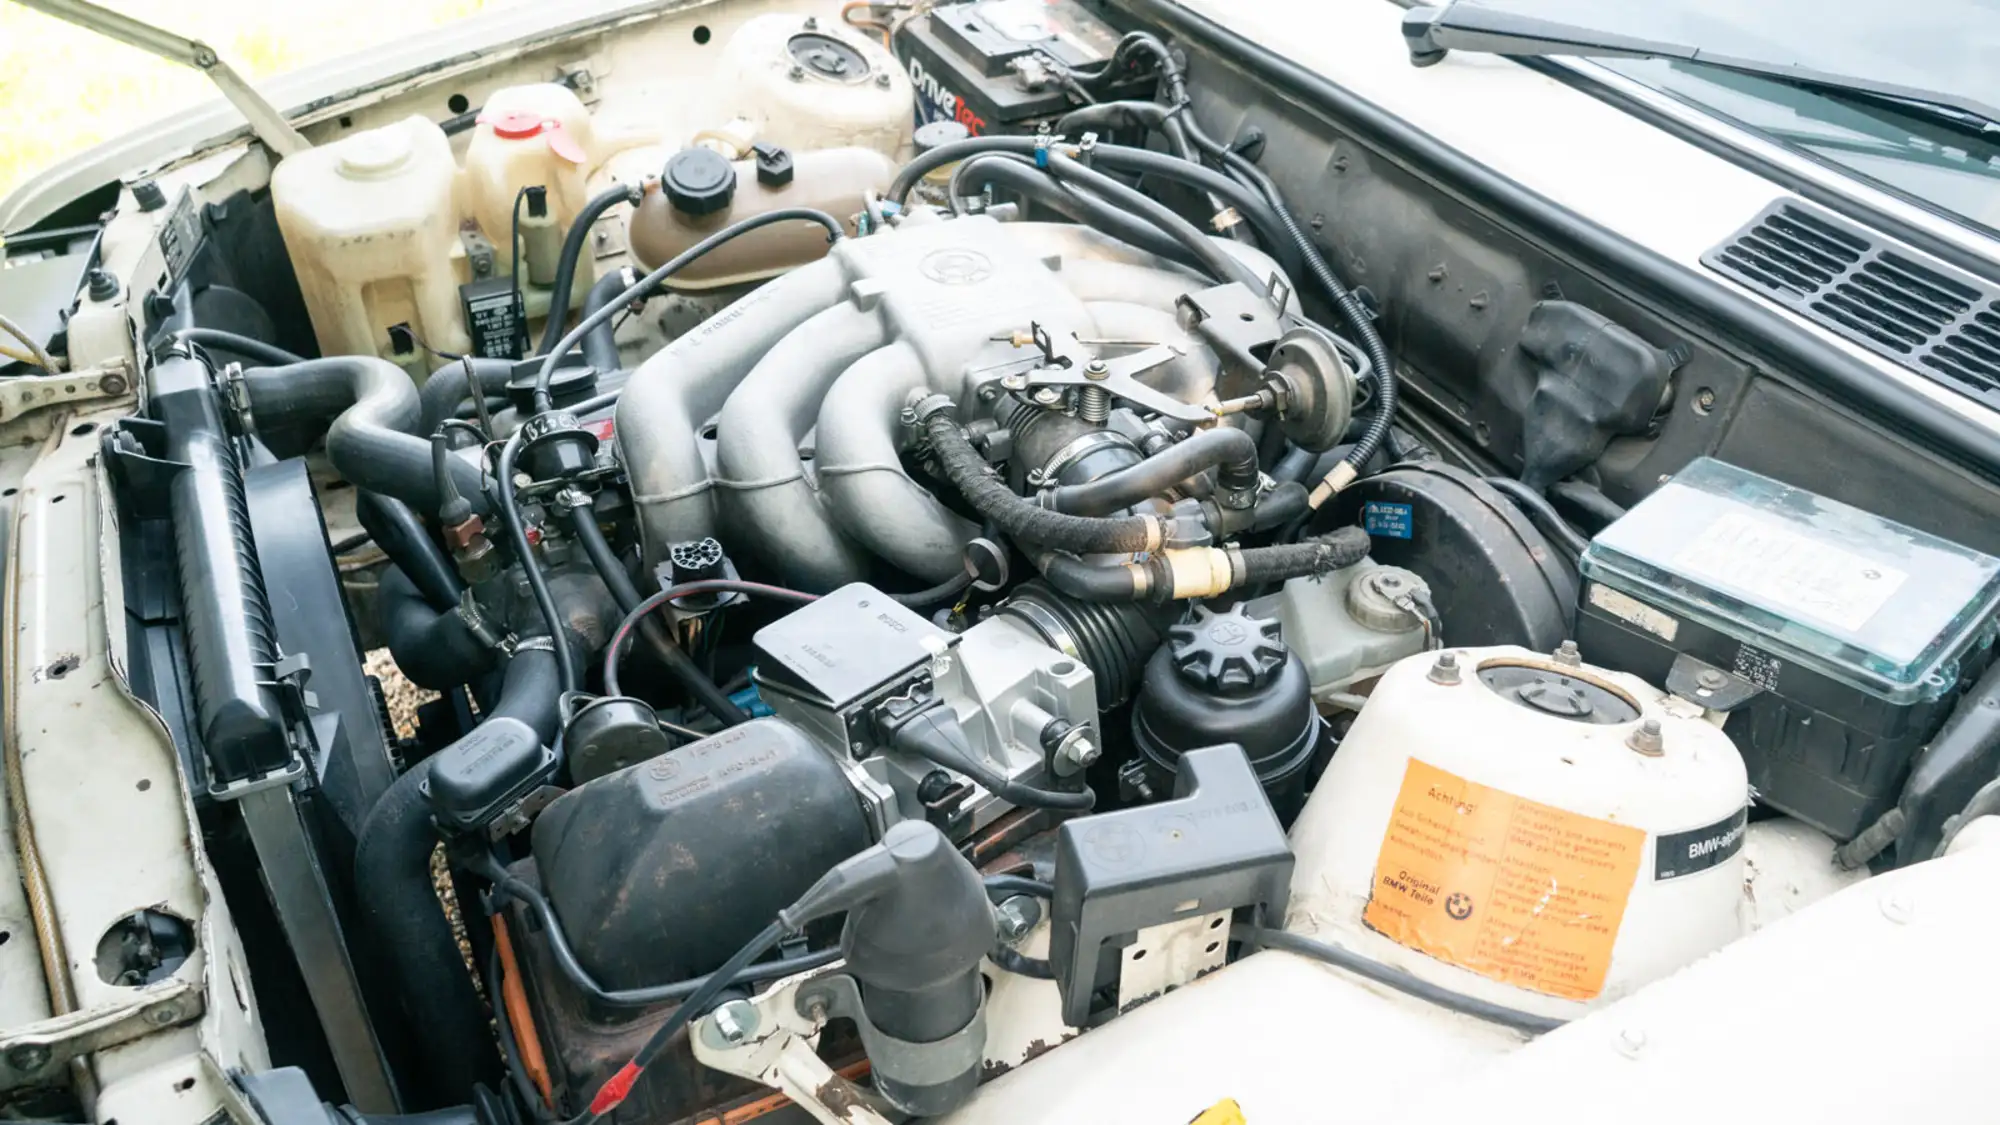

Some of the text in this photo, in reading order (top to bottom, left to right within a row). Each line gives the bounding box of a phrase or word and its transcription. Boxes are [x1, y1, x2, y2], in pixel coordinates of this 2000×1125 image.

[1382, 875, 1435, 906] BMW Teile
[1399, 869, 1441, 897] Original
